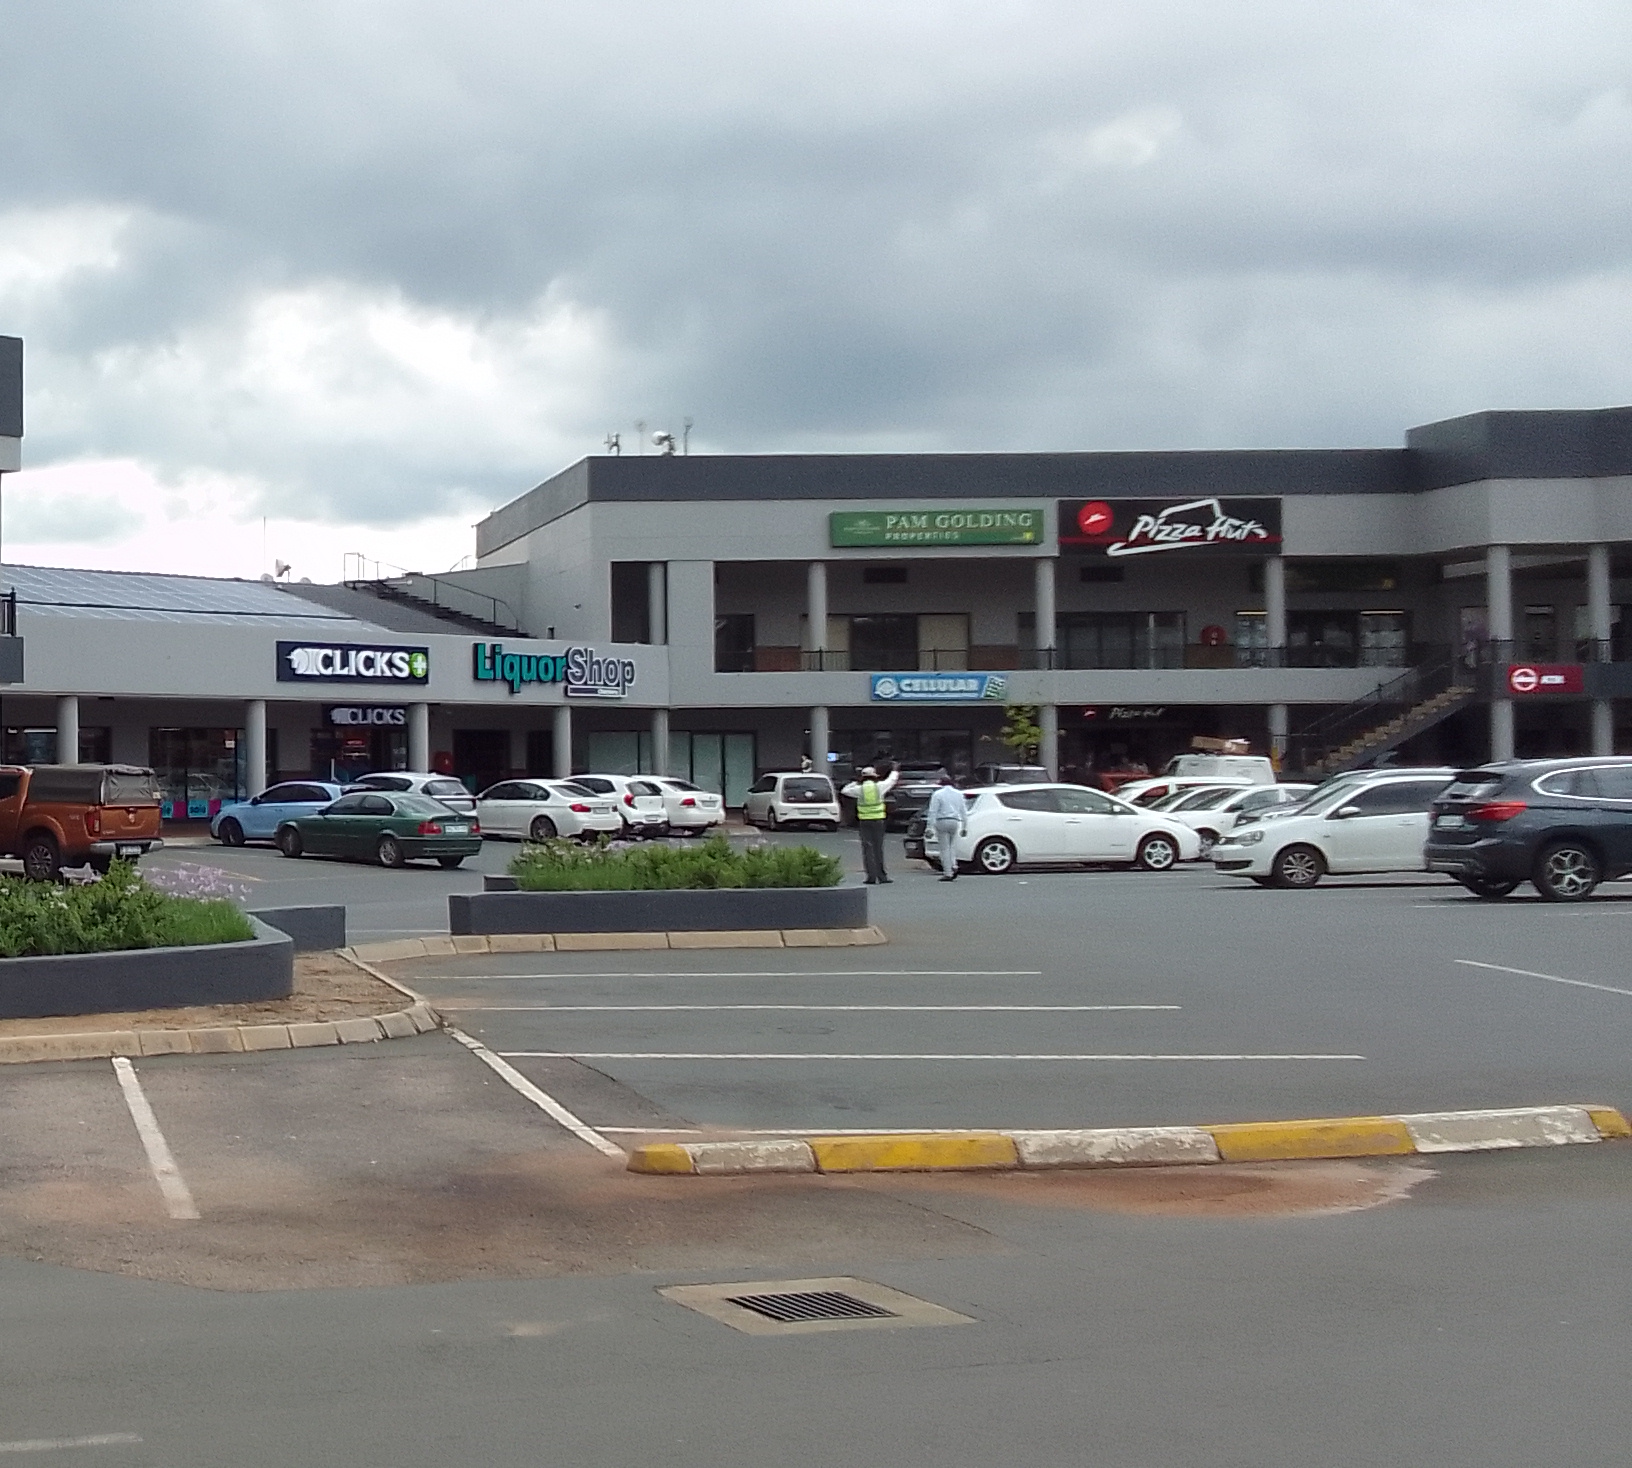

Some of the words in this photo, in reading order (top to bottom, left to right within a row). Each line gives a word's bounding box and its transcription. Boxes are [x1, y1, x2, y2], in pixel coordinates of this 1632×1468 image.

[886, 514, 927, 529] PAM
[935, 513, 1033, 529] GOLDING
[1128, 515, 1203, 542] Pizza
[1205, 515, 1268, 541] Hut
[885, 531, 959, 541] PROPERTIES
[317, 648, 410, 678] CLICKS
[900, 679, 979, 692] CELLULAR
[348, 709, 406, 725] CLICKS
